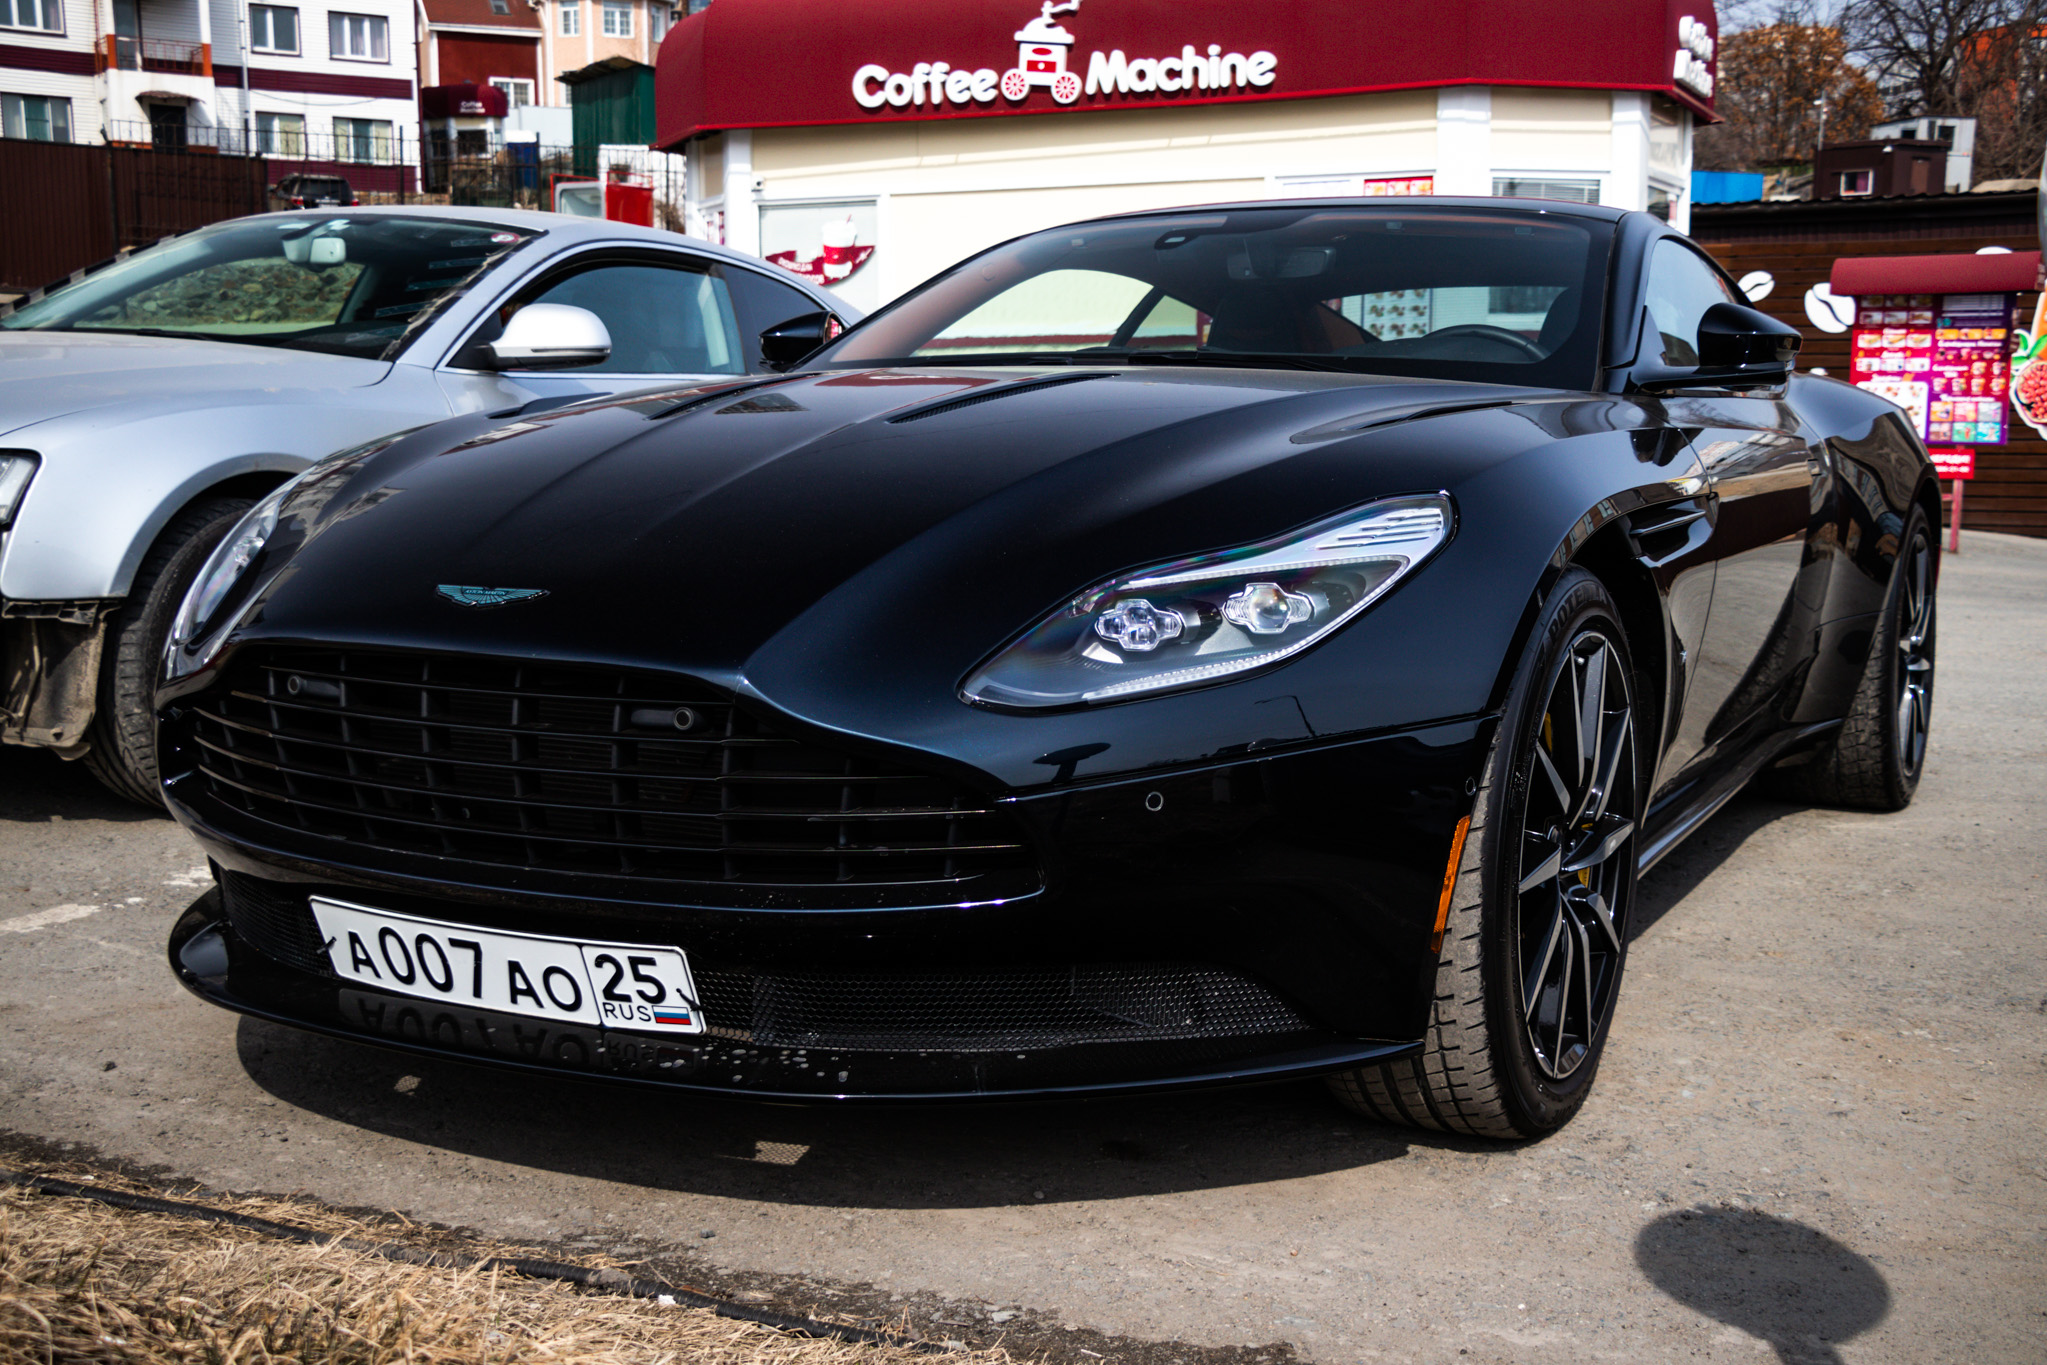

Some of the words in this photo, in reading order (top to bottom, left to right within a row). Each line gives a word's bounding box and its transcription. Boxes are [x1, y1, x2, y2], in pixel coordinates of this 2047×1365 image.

[852, 62, 999, 108] Coffee
[1085, 44, 1277, 96] Machine
[593, 953, 667, 1004] 25
[604, 1001, 652, 1023] RUS
